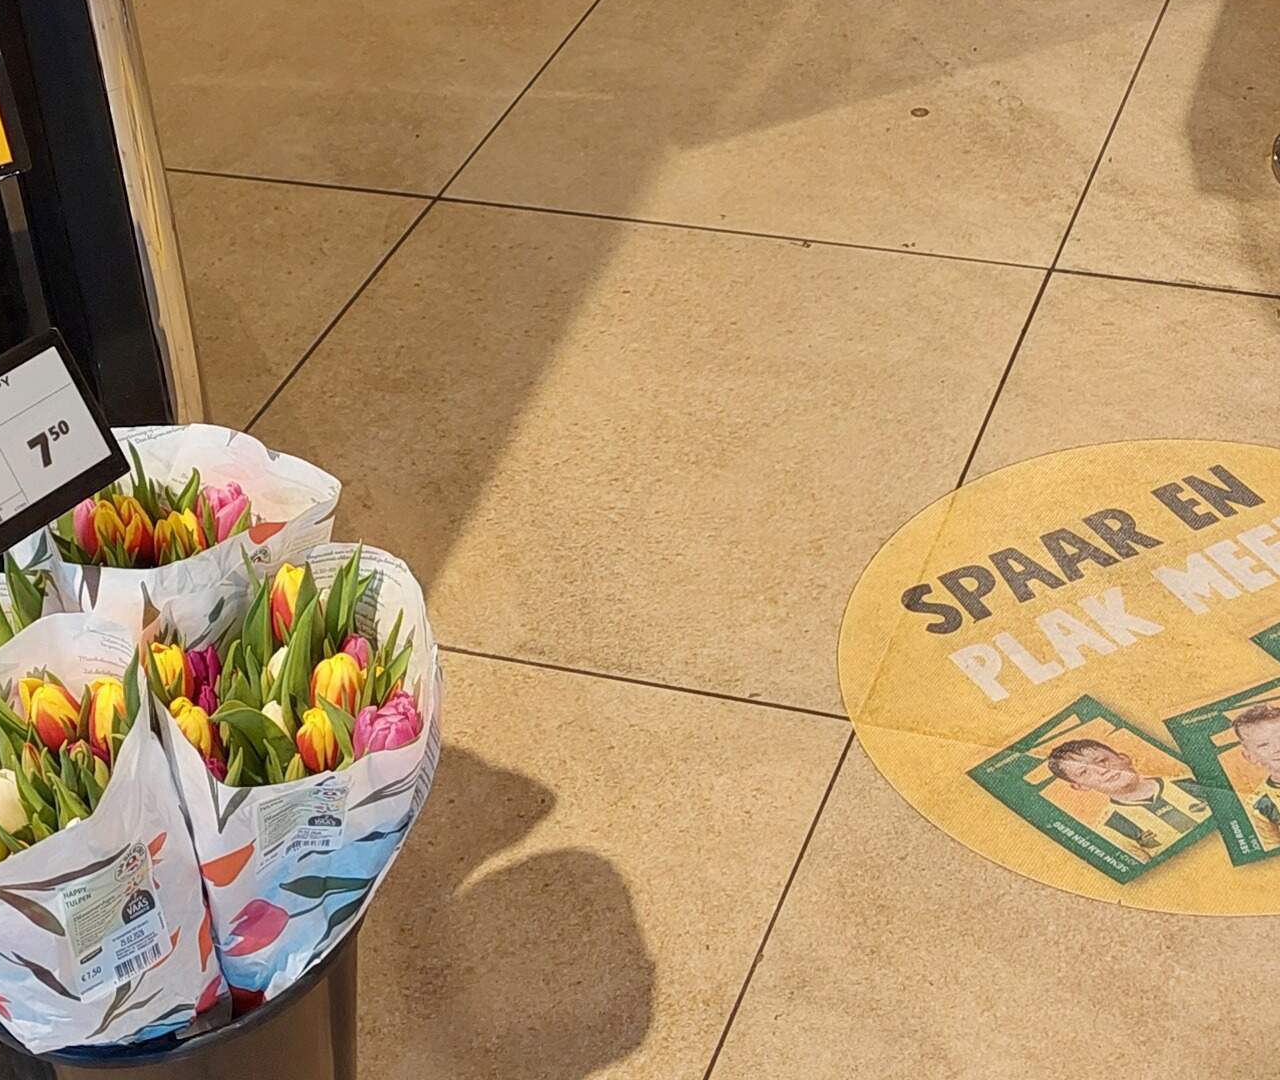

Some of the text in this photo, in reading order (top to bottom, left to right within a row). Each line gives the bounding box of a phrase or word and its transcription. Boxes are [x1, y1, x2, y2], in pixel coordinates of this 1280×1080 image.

[900, 464, 1266, 636] SPAAR EN
[947, 587, 1165, 703] PLAK
[1051, 819, 1075, 838] BERG
[1071, 832, 1091, 849] DEN
[1087, 843, 1106, 858] VAN
[63, 886, 87, 899] HAPPY
[65, 894, 92, 909] TULPEN
[126, 898, 149, 916] VAAS
